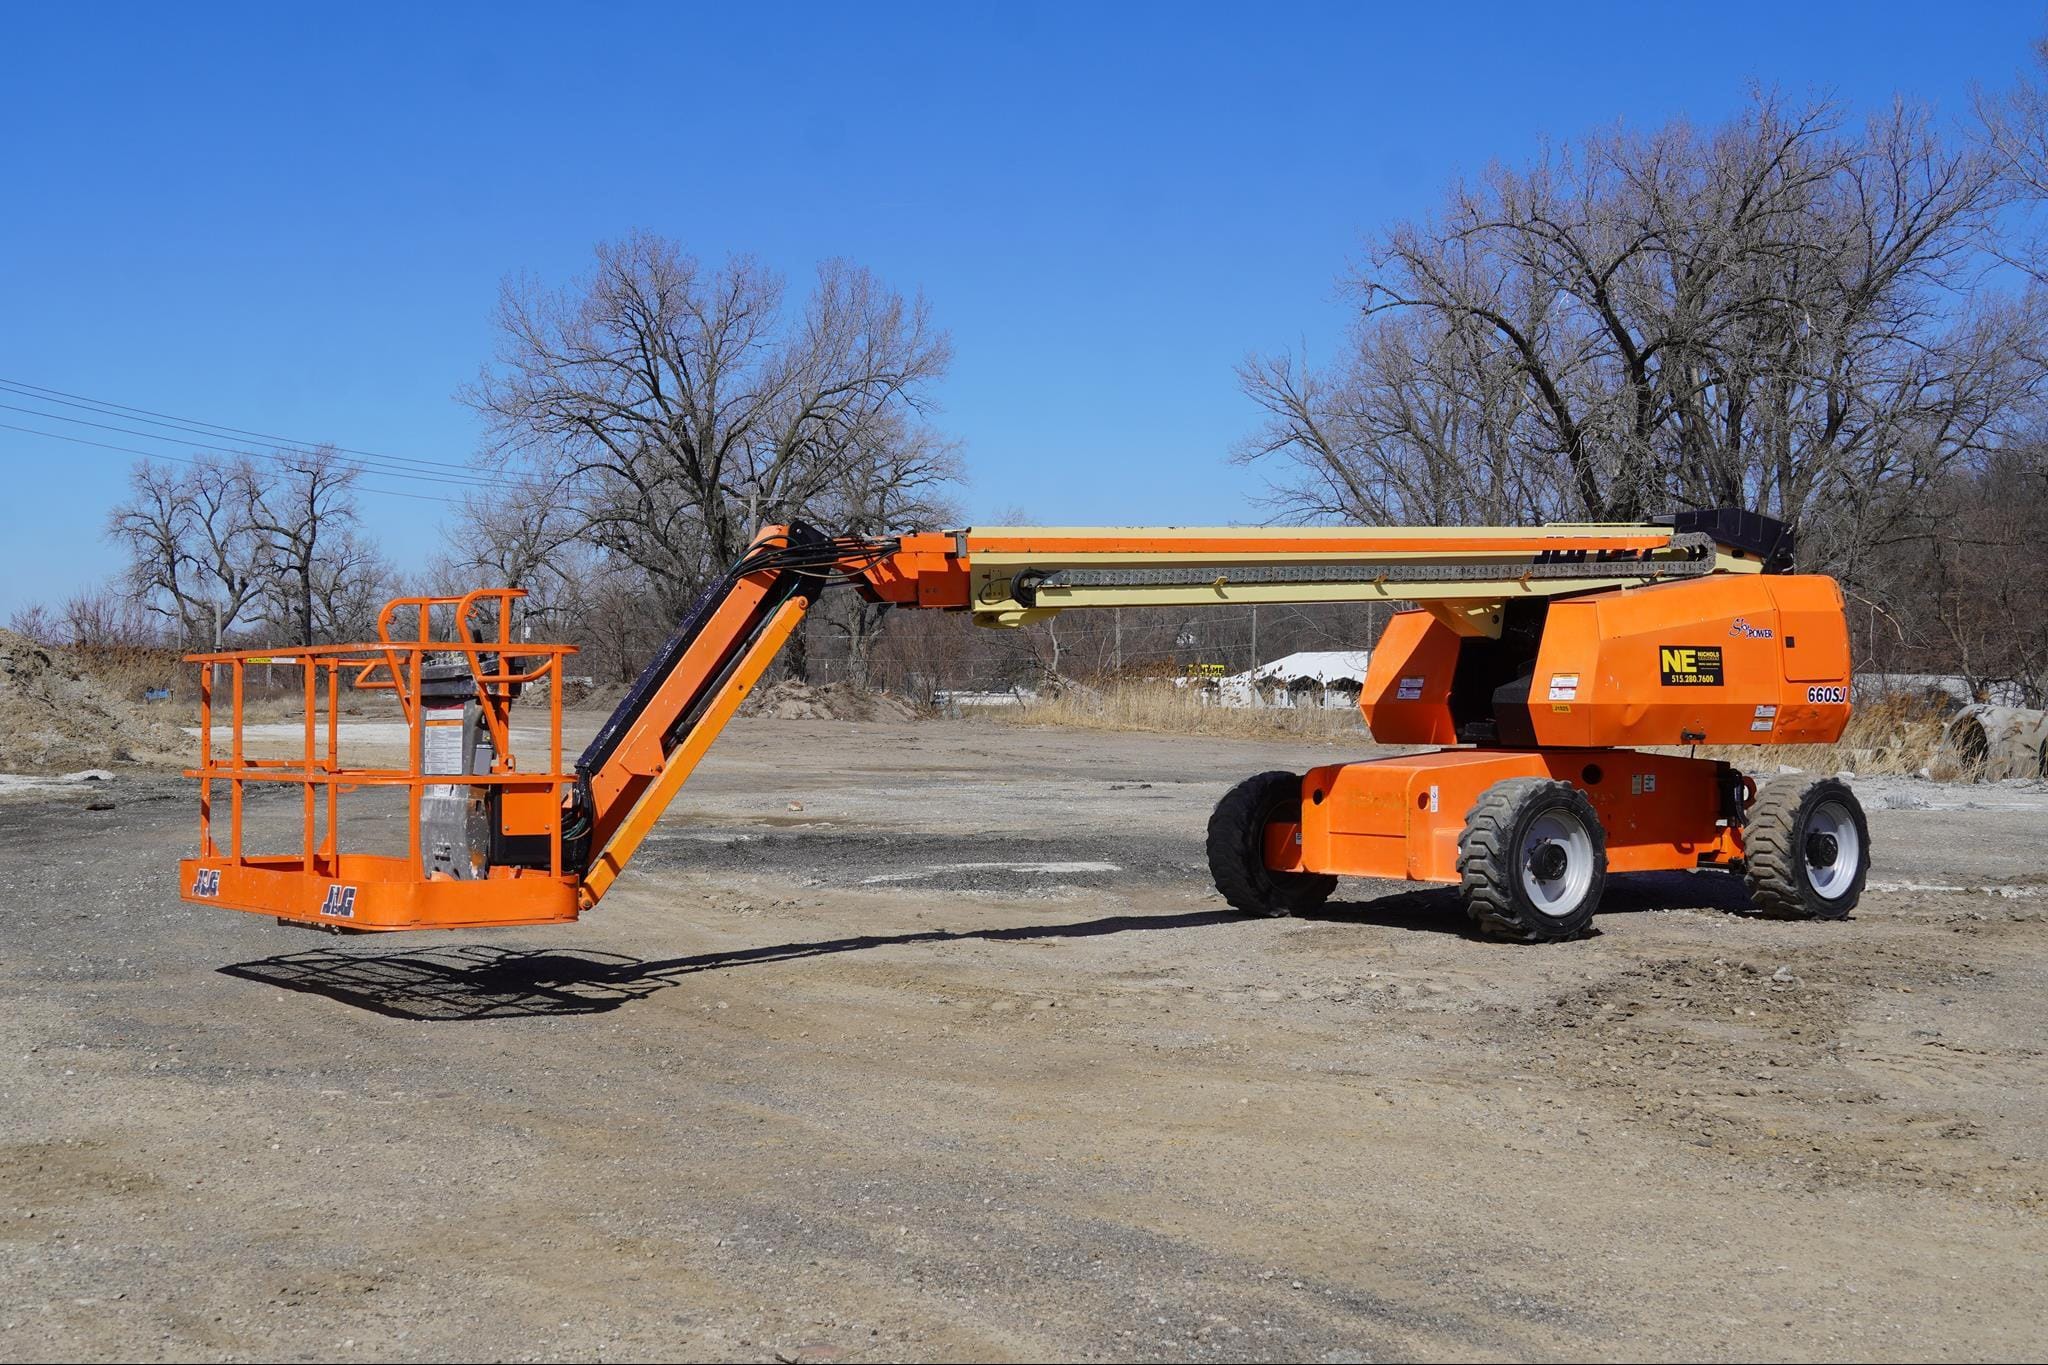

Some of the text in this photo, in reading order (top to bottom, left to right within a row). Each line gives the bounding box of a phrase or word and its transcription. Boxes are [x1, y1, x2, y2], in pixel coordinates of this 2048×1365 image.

[1661, 649, 1697, 673] NE
[1671, 674, 1714, 683] 515.280.7600
[1808, 687, 1847, 703] 660SJ
[193, 869, 220, 896] JLG
[321, 886, 356, 917] JLG
